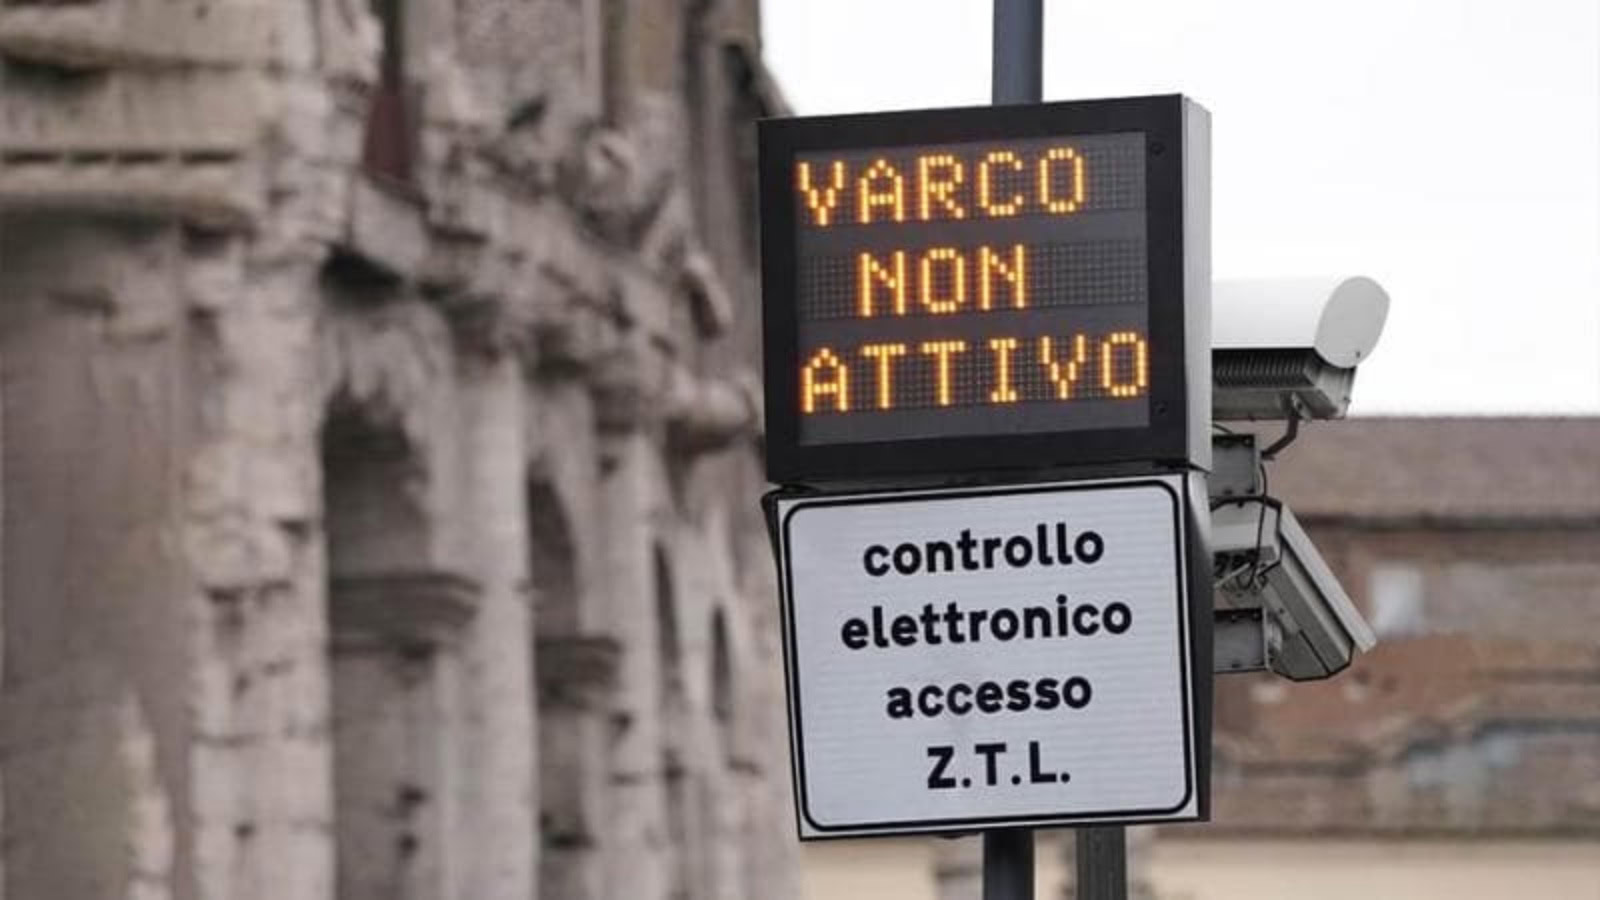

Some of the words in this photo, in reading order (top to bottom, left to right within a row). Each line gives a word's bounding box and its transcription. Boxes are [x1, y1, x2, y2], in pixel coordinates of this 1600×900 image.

[797, 147, 1085, 226] VARCO
[858, 244, 1027, 317] NON
[801, 331, 1147, 413] ATTIVO
[862, 522, 1105, 577] controllo
[840, 593, 1133, 651] elettronico
[885, 676, 1094, 719] accesso
[926, 740, 1071, 790] Z.T.L.
